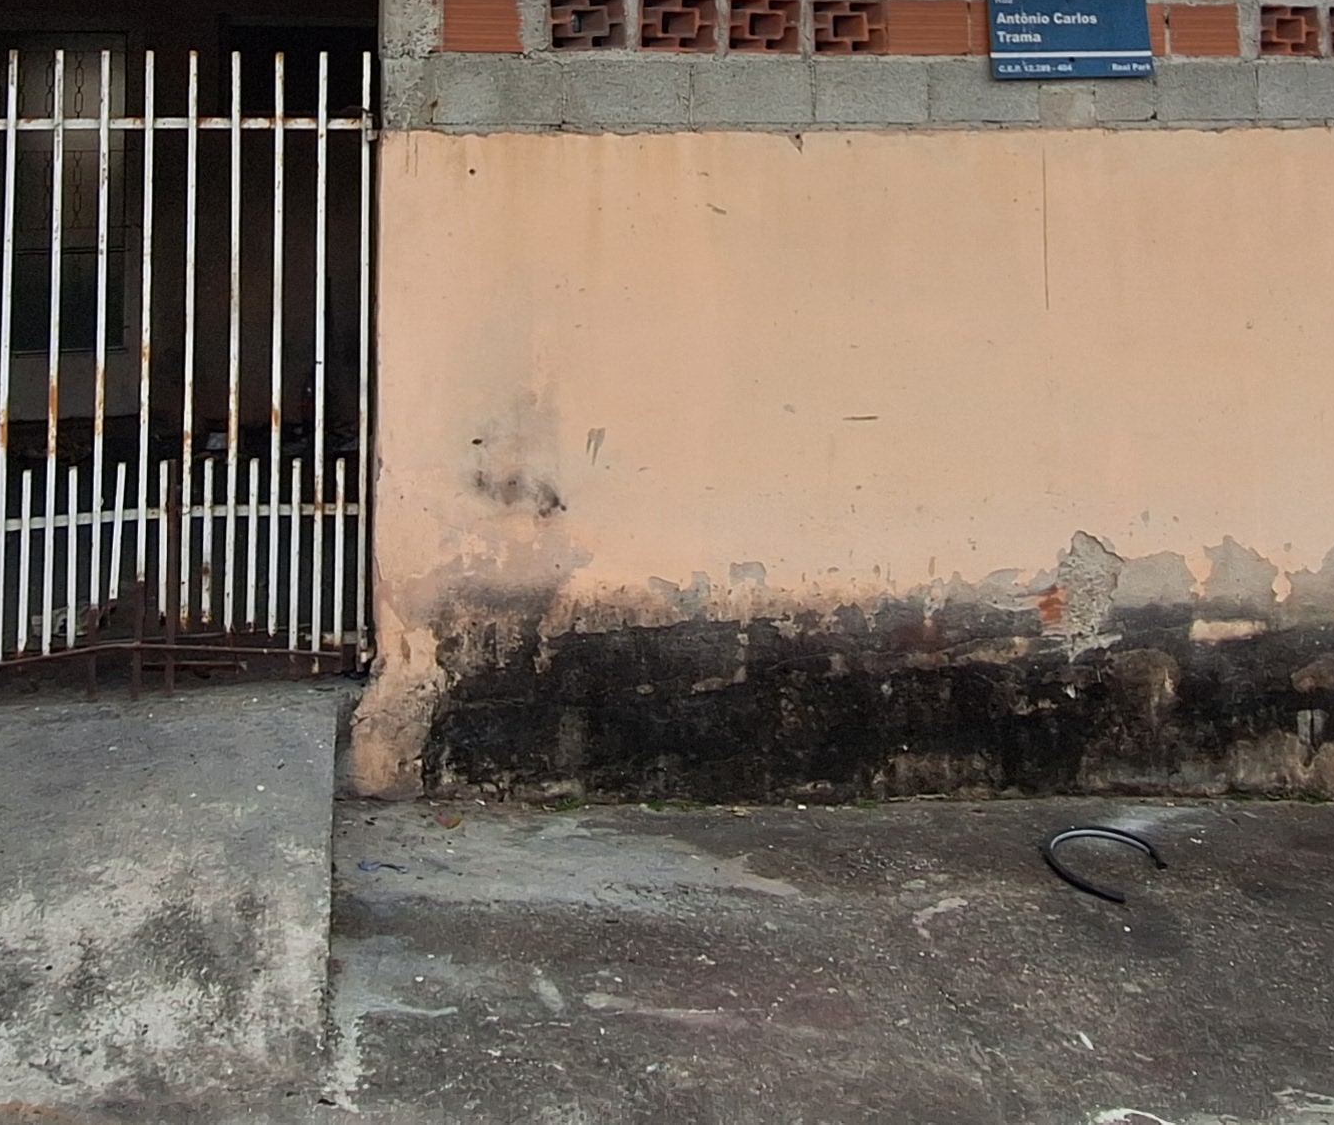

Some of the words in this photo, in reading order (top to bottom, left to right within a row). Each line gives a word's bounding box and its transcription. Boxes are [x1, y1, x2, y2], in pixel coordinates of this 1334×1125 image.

[996, 12, 1050, 24] Antônio
[1053, 12, 1098, 24] Carlos
[996, 31, 1042, 43] Trama
[1132, 62, 1151, 71] Park
